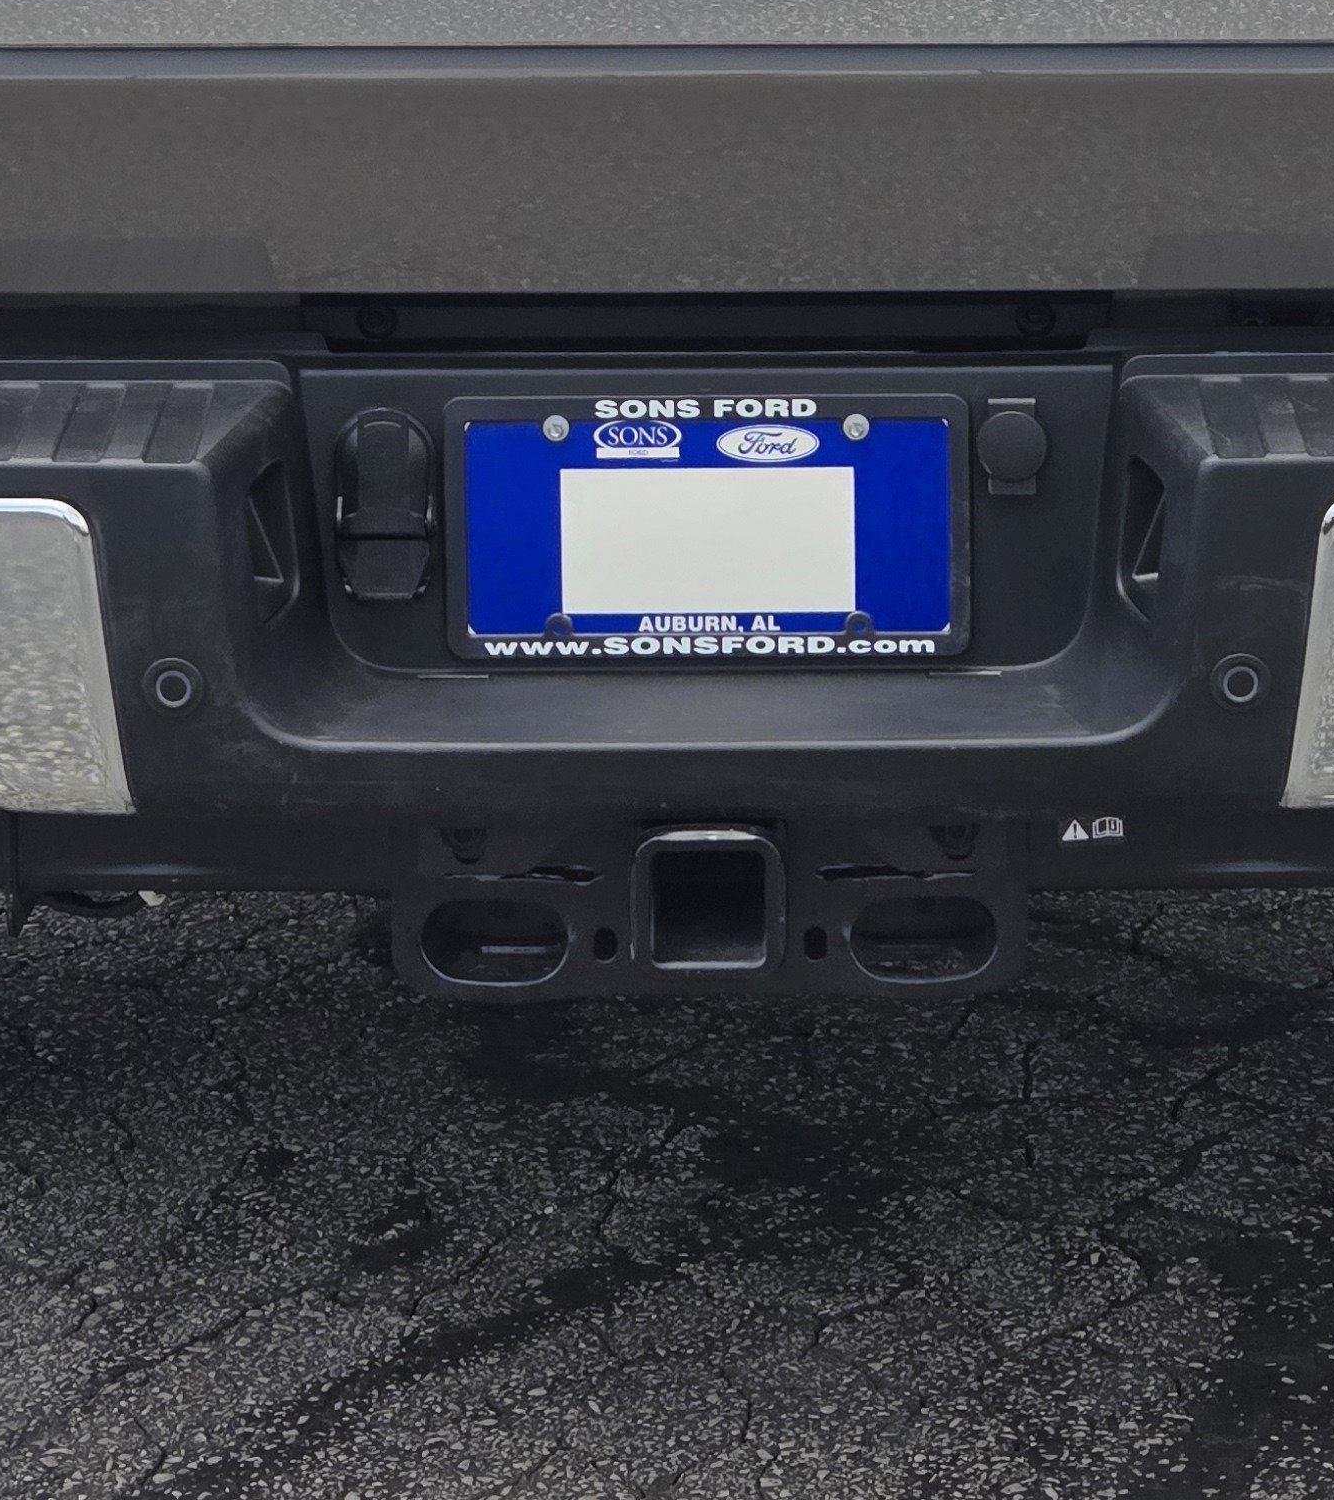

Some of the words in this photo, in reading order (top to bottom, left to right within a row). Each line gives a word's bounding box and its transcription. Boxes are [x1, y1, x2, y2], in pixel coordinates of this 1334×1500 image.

[594, 399, 701, 419] SONS
[713, 398, 817, 418] FORD
[607, 426, 669, 446] SONS
[737, 429, 798, 457] Ford
[638, 616, 743, 634] AUBURN,
[750, 615, 781, 632] AL
[484, 636, 936, 656] www.SONSFORD.com
